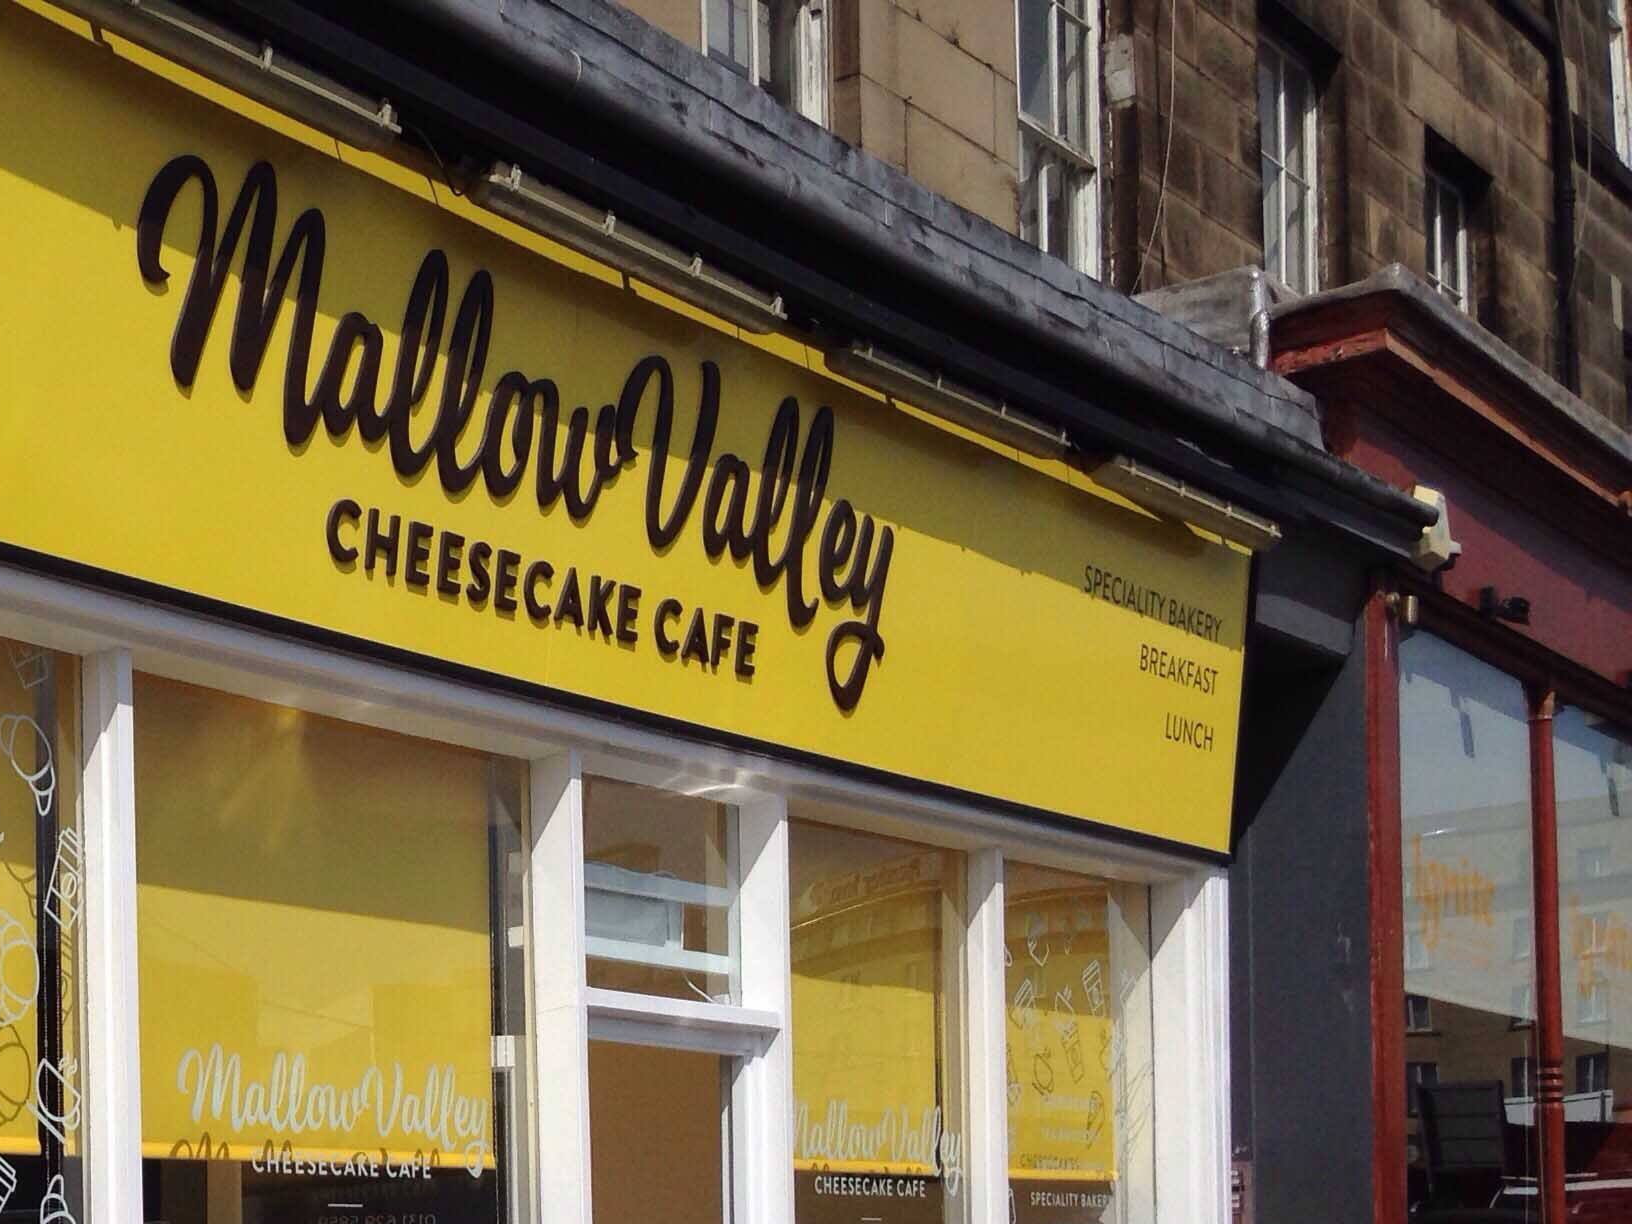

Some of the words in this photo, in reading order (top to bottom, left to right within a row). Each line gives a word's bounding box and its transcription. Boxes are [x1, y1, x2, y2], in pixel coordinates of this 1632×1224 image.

[136, 154, 626, 523] Mallow
[615, 355, 895, 712] Valley
[326, 499, 639, 643] CHEESECAKE
[654, 598, 760, 677] CAFE
[1084, 564, 1167, 619] SPECIALITY
[1168, 599, 1223, 643] BAKERY
[1139, 643, 1218, 695] BREAKFAST
[1165, 712, 1214, 752] LUNCH
[177, 1042, 369, 1134] Mallow
[357, 1063, 489, 1178] Valley
[252, 1153, 379, 1177] CHEESECAKE
[386, 1159, 432, 1180] CAFE
[814, 1175, 893, 1197] CHEESECAKE
[897, 1179, 926, 1198] CAFE
